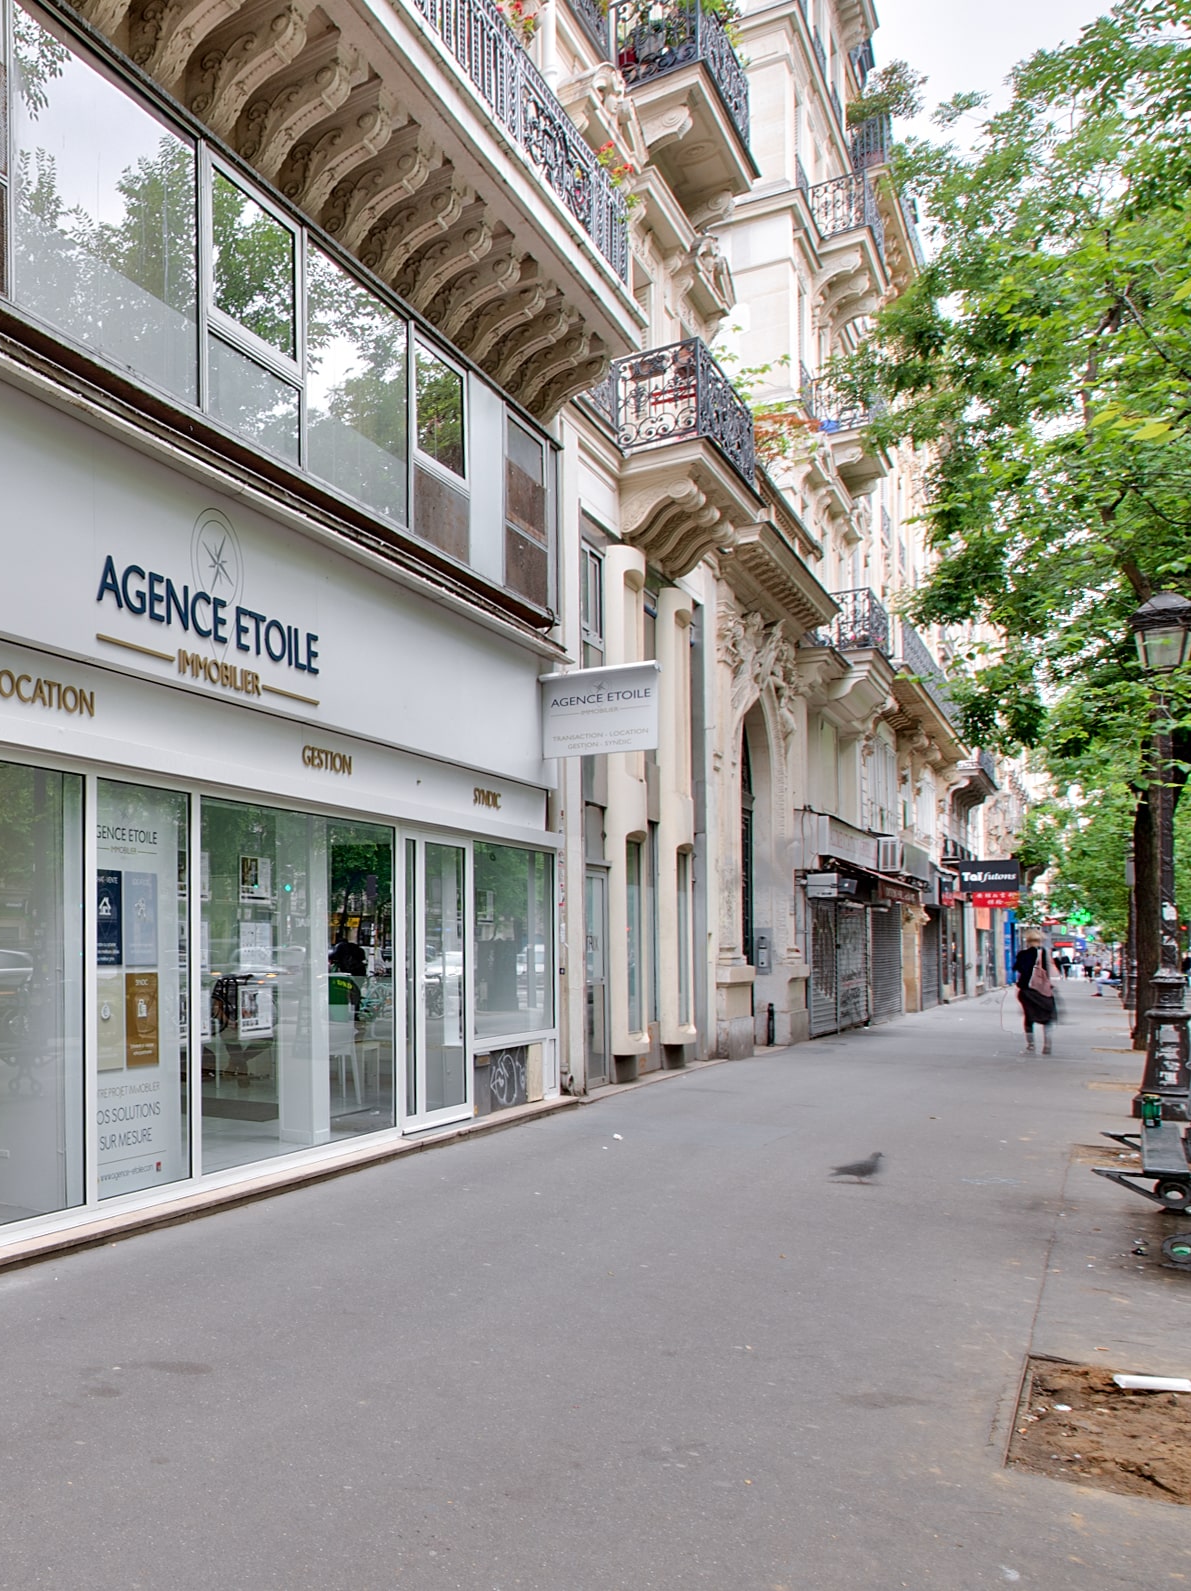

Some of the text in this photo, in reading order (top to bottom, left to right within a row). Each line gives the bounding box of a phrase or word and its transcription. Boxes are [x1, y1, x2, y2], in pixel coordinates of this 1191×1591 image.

[96, 554, 320, 674] AGENCE ETOILE
[177, 648, 262, 696] IMMOBILIER
[550, 687, 652, 708] AGENCE ETOILE
[552, 731, 604, 742] TRANSACTION
[609, 727, 649, 738] LOCATION
[567, 742, 599, 750] GESTION
[604, 738, 632, 746] SYNDIC
[302, 744, 352, 776] GESTION
[472, 786, 502, 811] SYNDIC
[96, 824, 158, 845] GENCE ETOILE
[980, 871, 1017, 883] futons
[97, 1101, 161, 1125] OS SOLUTIONS
[99, 1127, 153, 1151] SUR MESURE
